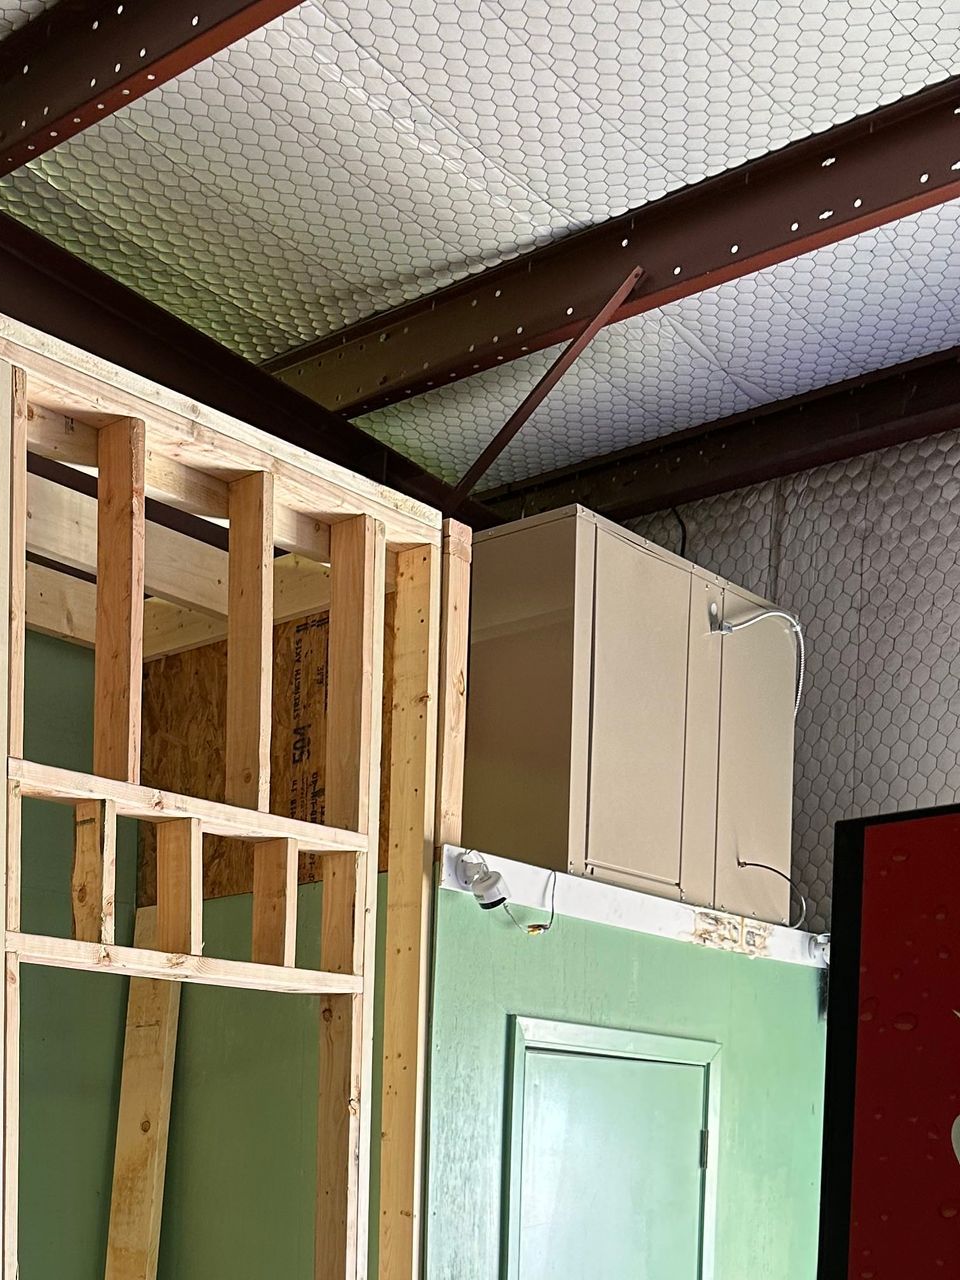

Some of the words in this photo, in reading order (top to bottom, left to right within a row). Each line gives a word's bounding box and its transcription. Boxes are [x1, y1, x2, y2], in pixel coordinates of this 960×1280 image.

[294, 638, 303, 663] AXIS
[292, 668, 302, 720] STRENGTH
[291, 722, 312, 764] 504
